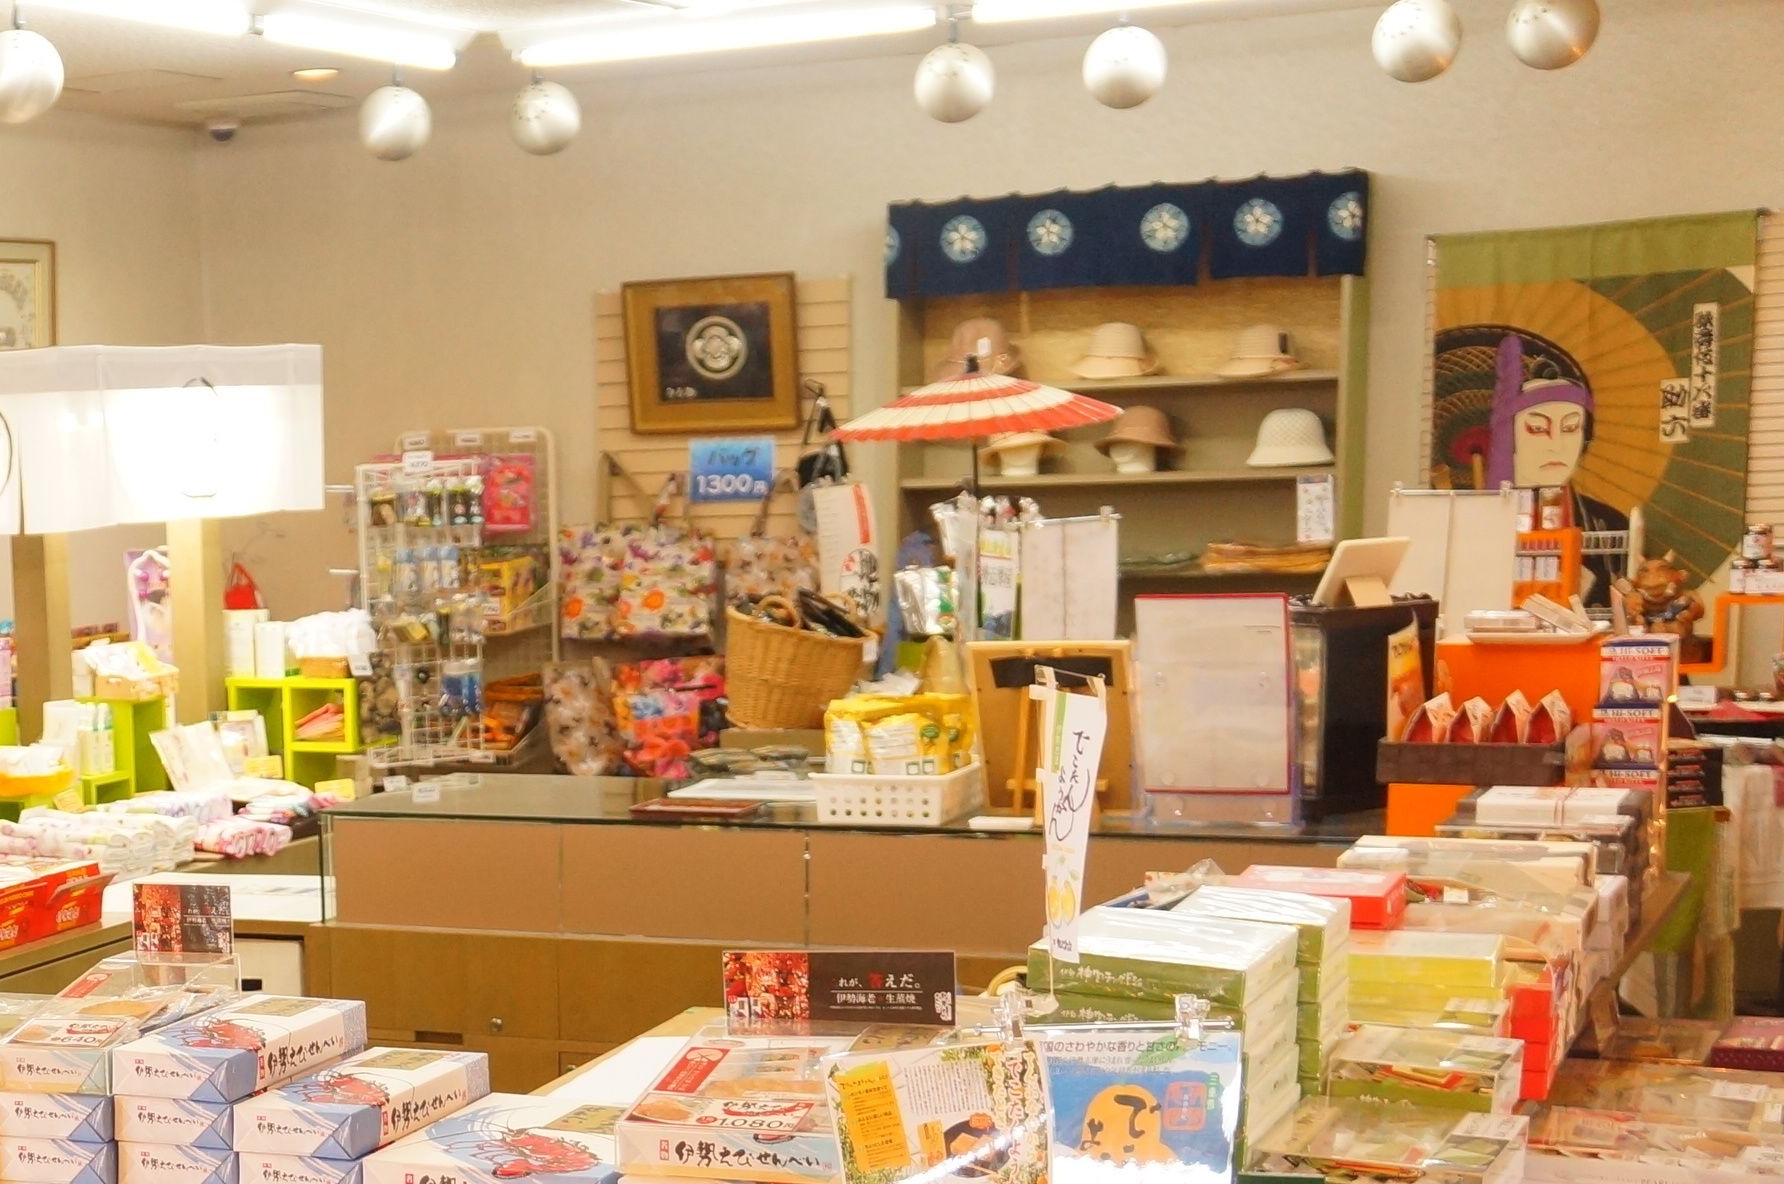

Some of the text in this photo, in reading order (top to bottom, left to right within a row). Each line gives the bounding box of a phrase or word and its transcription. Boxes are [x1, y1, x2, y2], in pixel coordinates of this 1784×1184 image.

[675, 1140, 820, 1167] 伊勢えびせんべい
